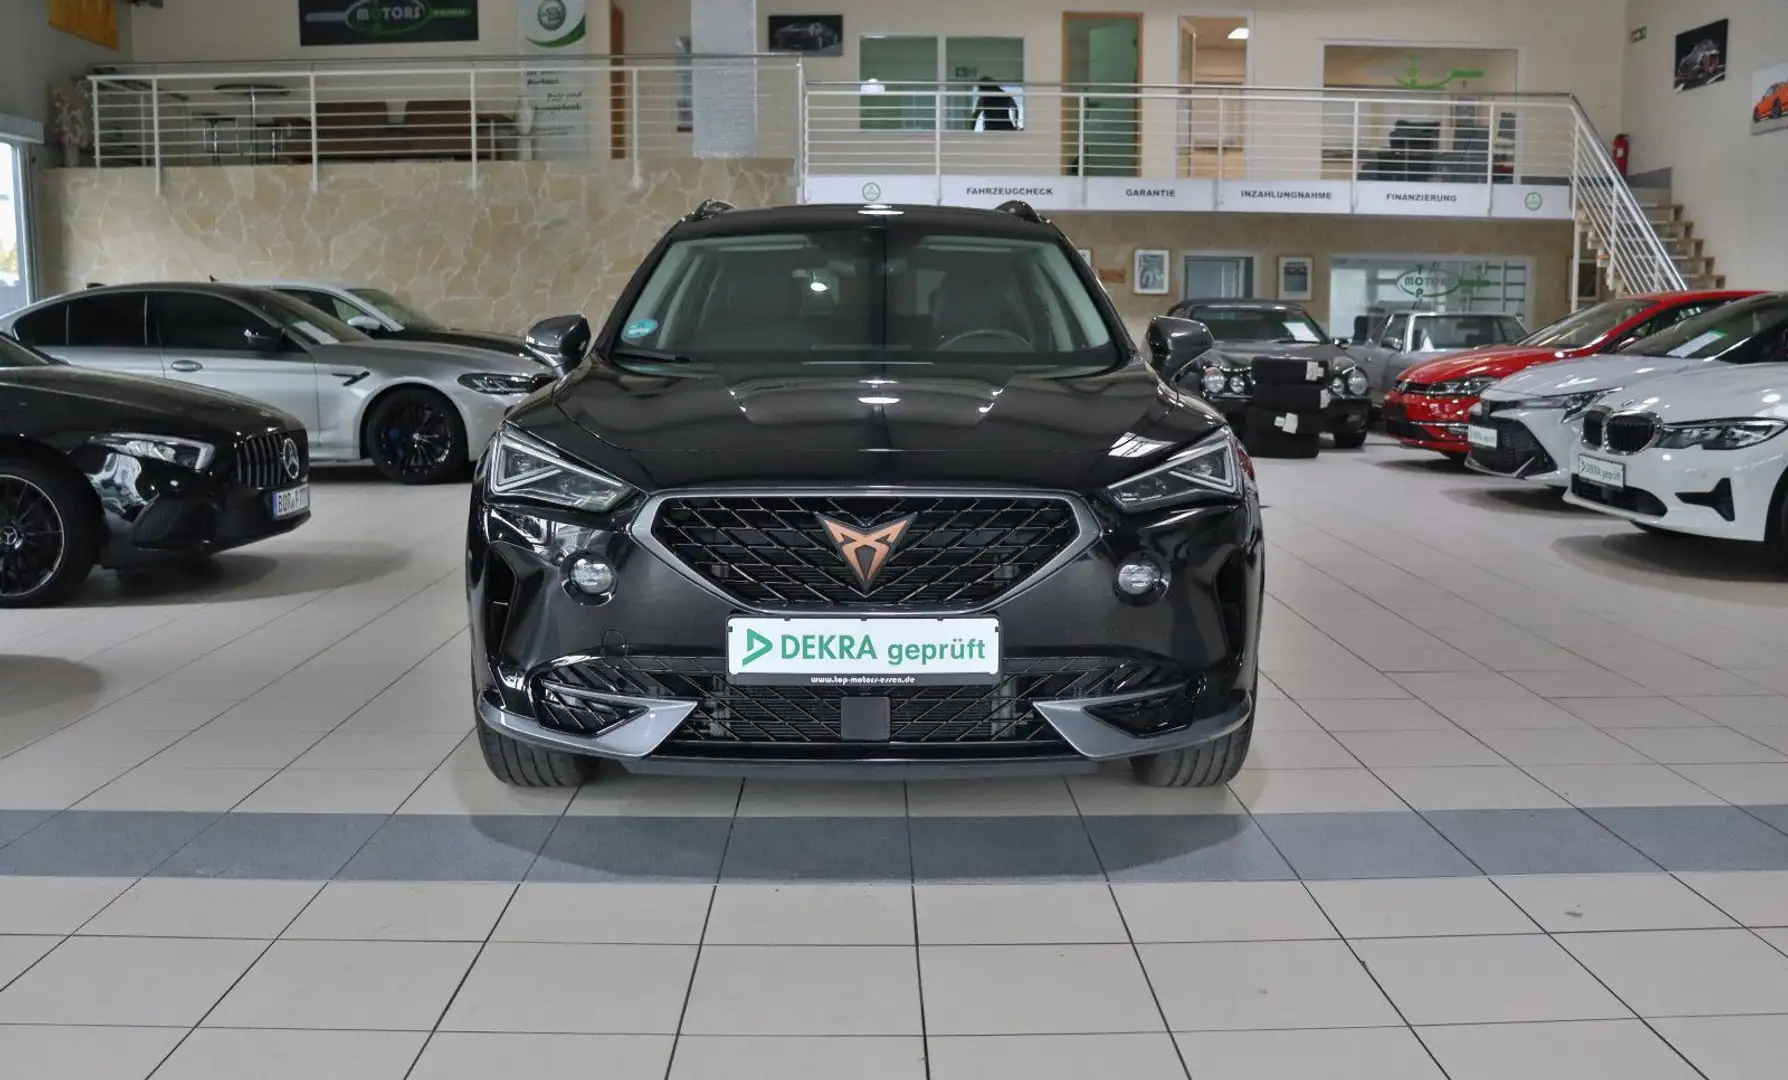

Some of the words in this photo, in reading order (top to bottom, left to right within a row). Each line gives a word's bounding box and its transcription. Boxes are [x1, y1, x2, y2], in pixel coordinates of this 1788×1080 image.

[356, 6, 420, 21] MOTORS
[966, 187, 1053, 196] FAHRZEUGCHECK
[1125, 188, 1177, 198] GARANTIE
[1240, 190, 1333, 200] INZAHLUNGNAHME
[1386, 193, 1458, 202] FINANZIERUNG
[781, 634, 878, 660] DEKRA
[887, 638, 986, 666] geprüft
[810, 674, 916, 685] www.top-motors-essen.de
